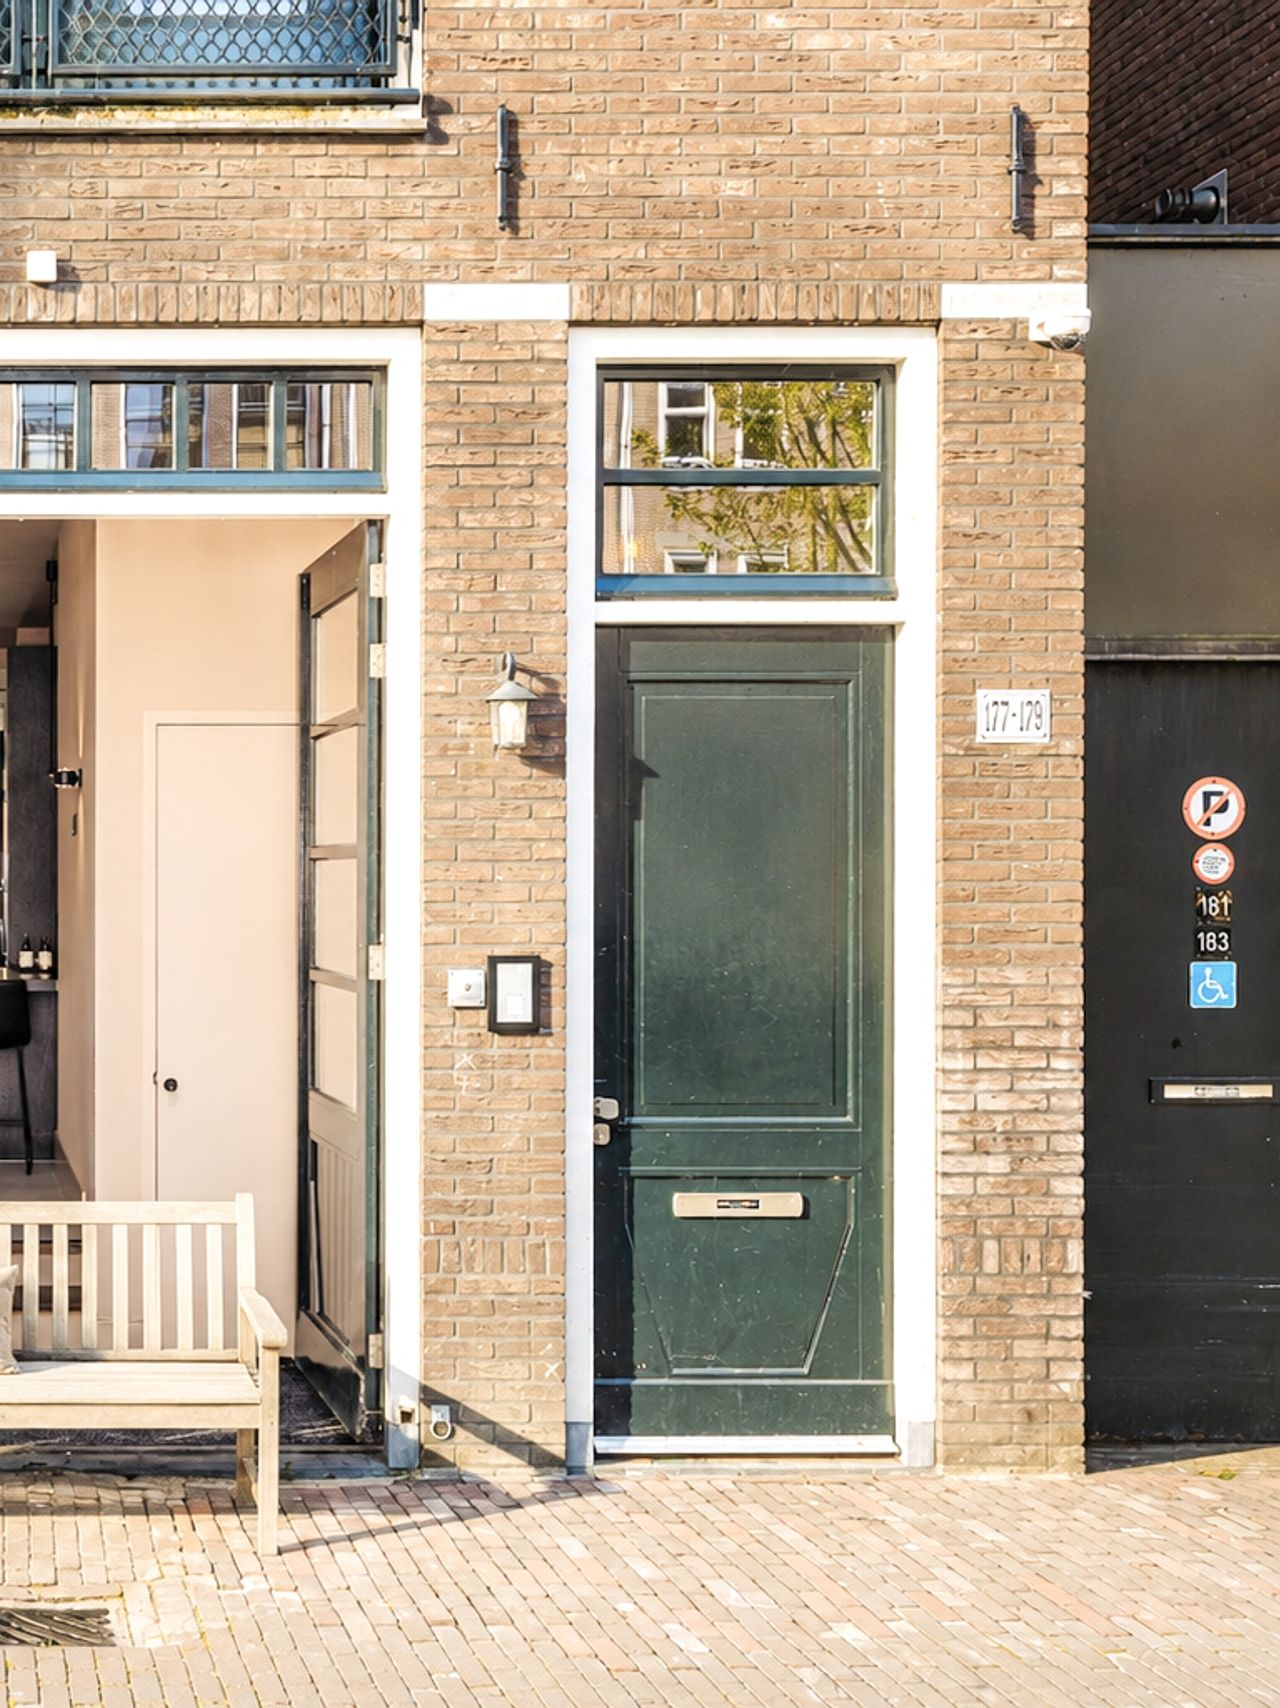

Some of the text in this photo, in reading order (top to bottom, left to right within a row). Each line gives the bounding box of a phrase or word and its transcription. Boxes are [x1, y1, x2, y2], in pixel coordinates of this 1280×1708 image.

[1202, 790, 1229, 827] P
[1197, 895, 1229, 916] 181
[1197, 931, 1229, 952] 183
